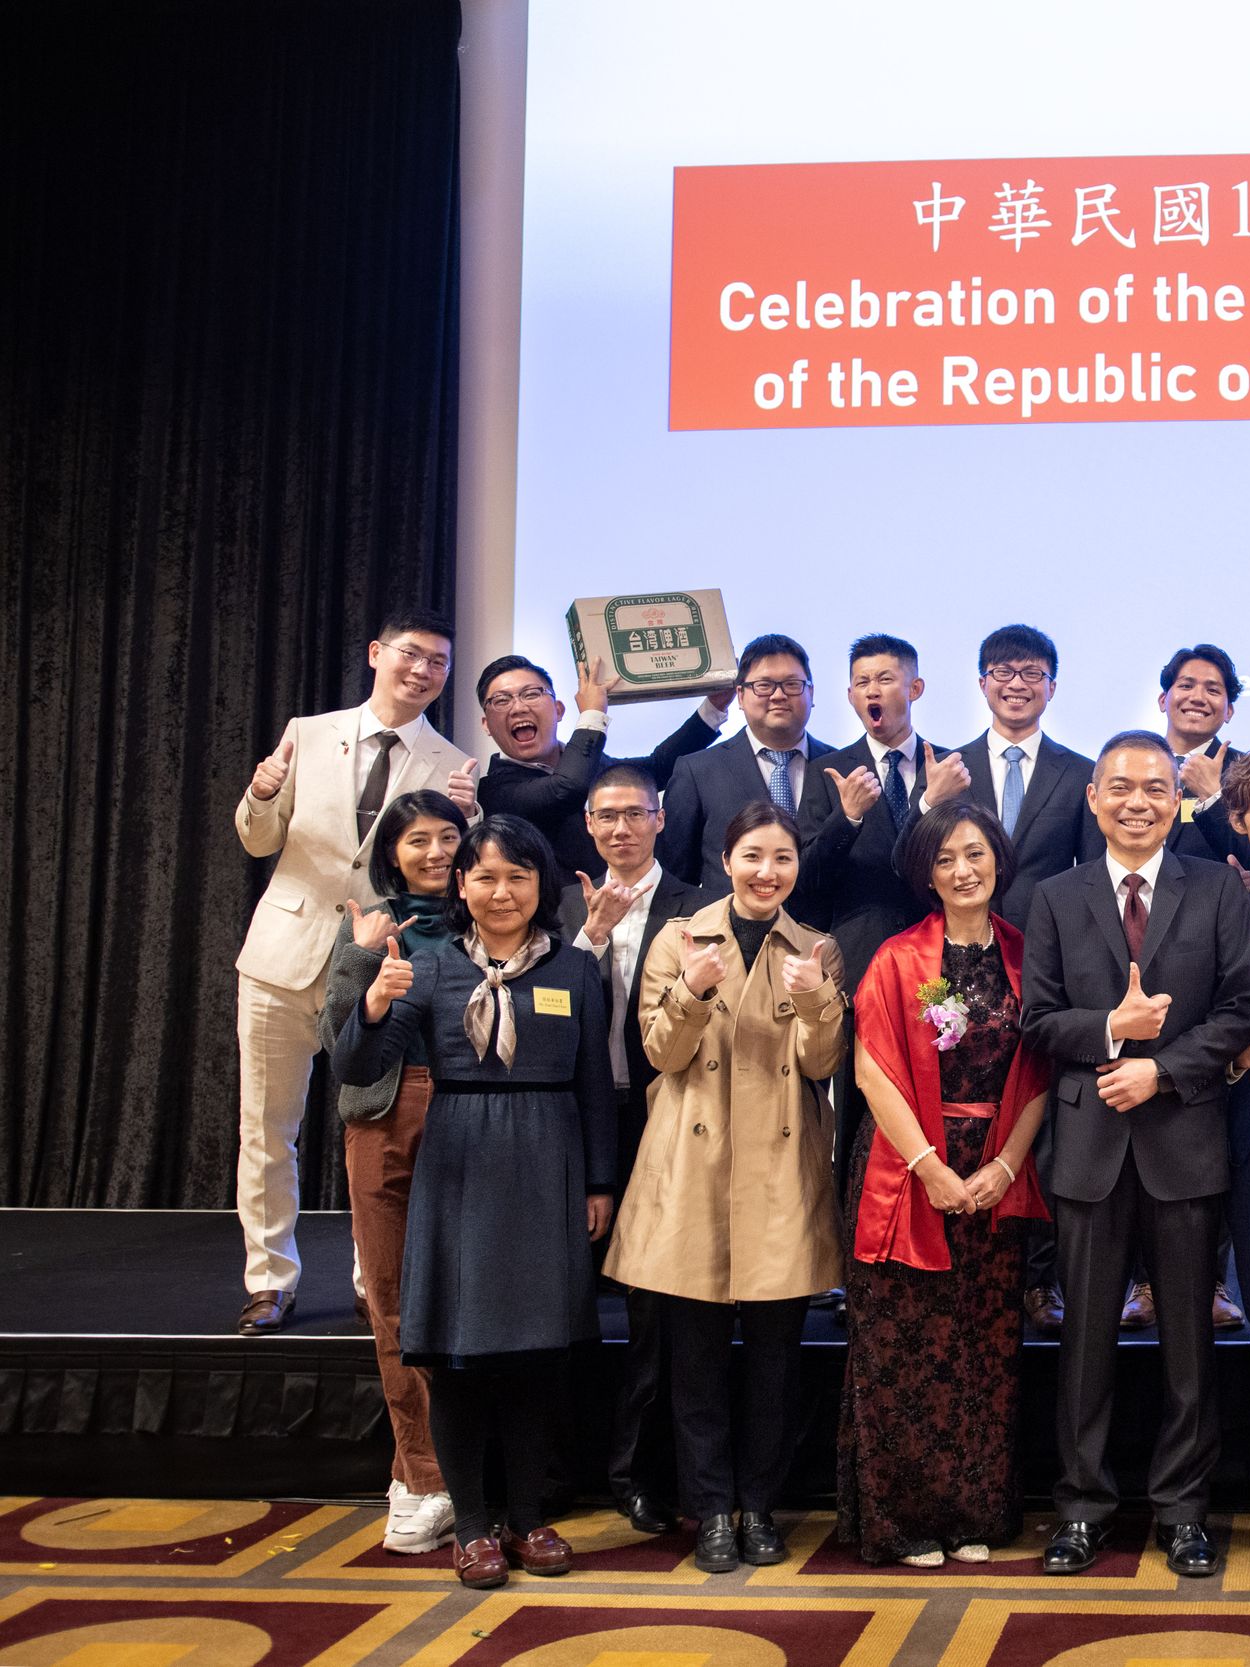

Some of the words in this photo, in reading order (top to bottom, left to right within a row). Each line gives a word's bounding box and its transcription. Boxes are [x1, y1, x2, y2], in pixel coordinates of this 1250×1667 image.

[720, 277, 1054, 331] Celebration
[1079, 274, 1133, 323] of
[1153, 273, 1245, 321] the
[754, 359, 808, 409] of
[828, 358, 918, 408] the
[943, 352, 1196, 417] Republic
